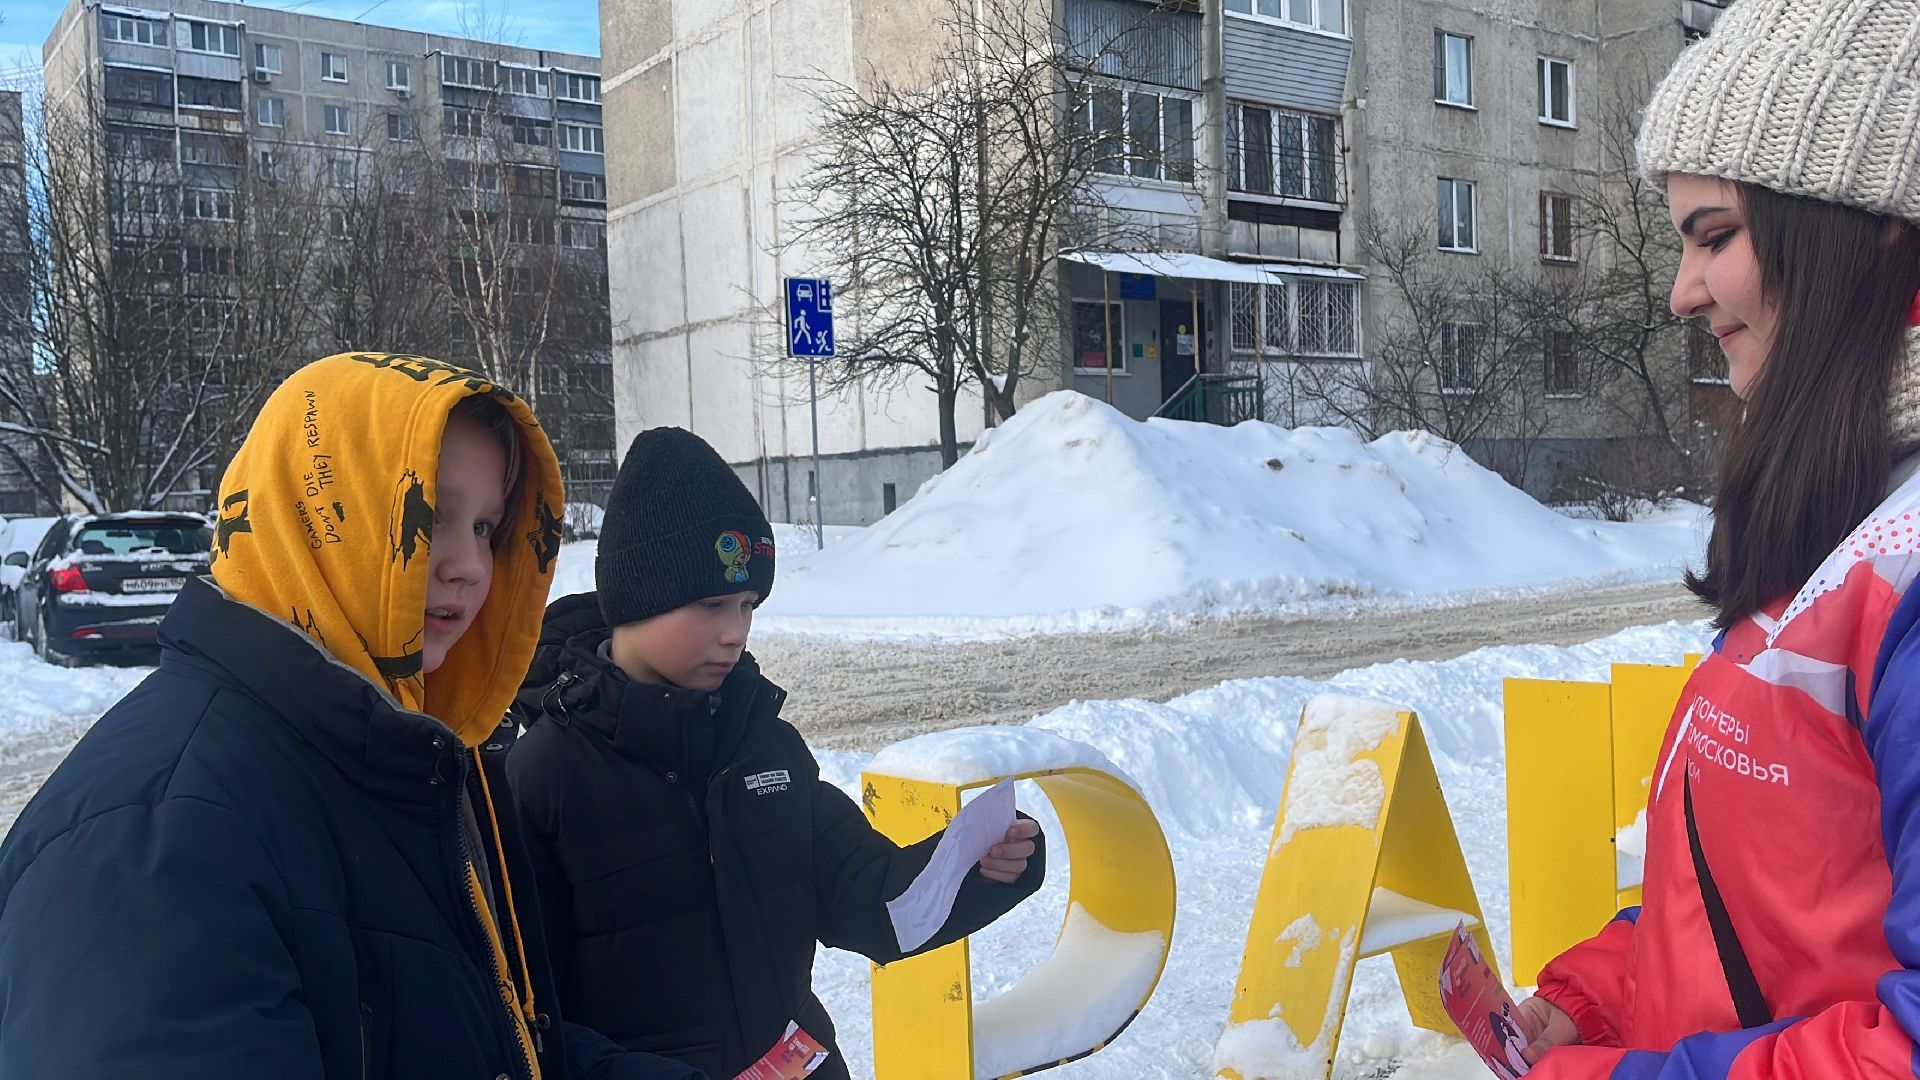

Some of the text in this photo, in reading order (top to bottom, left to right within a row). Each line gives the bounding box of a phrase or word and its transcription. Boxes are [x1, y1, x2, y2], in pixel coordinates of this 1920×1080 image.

[304, 390, 333, 490] THEY RESPAWN
[295, 500, 322, 550] GAMERS
[304, 472, 342, 544] DON'T DIE
